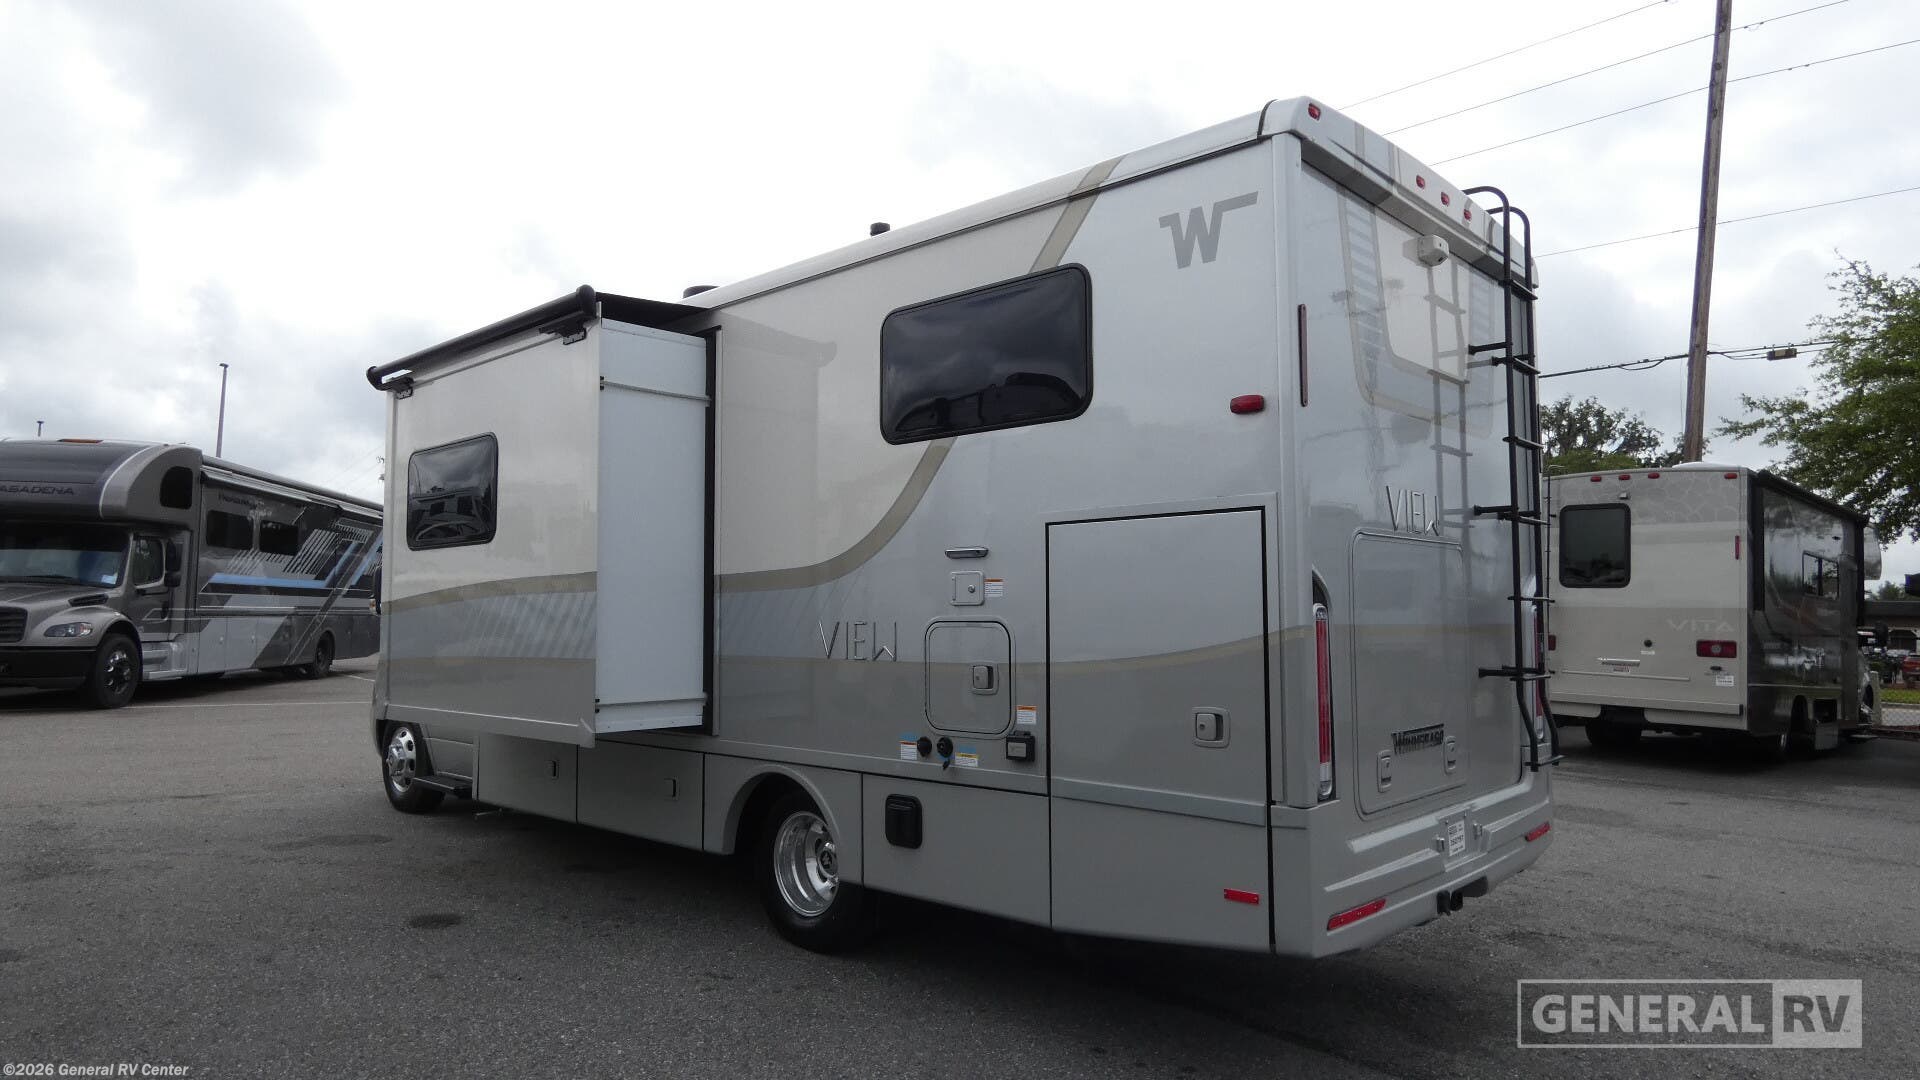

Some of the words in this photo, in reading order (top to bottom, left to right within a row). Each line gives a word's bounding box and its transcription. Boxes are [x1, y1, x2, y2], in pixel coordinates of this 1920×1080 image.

[1386, 485, 1440, 536] VIEW
[819, 620, 897, 662] VIEW
[1664, 618, 1735, 632] VITA
